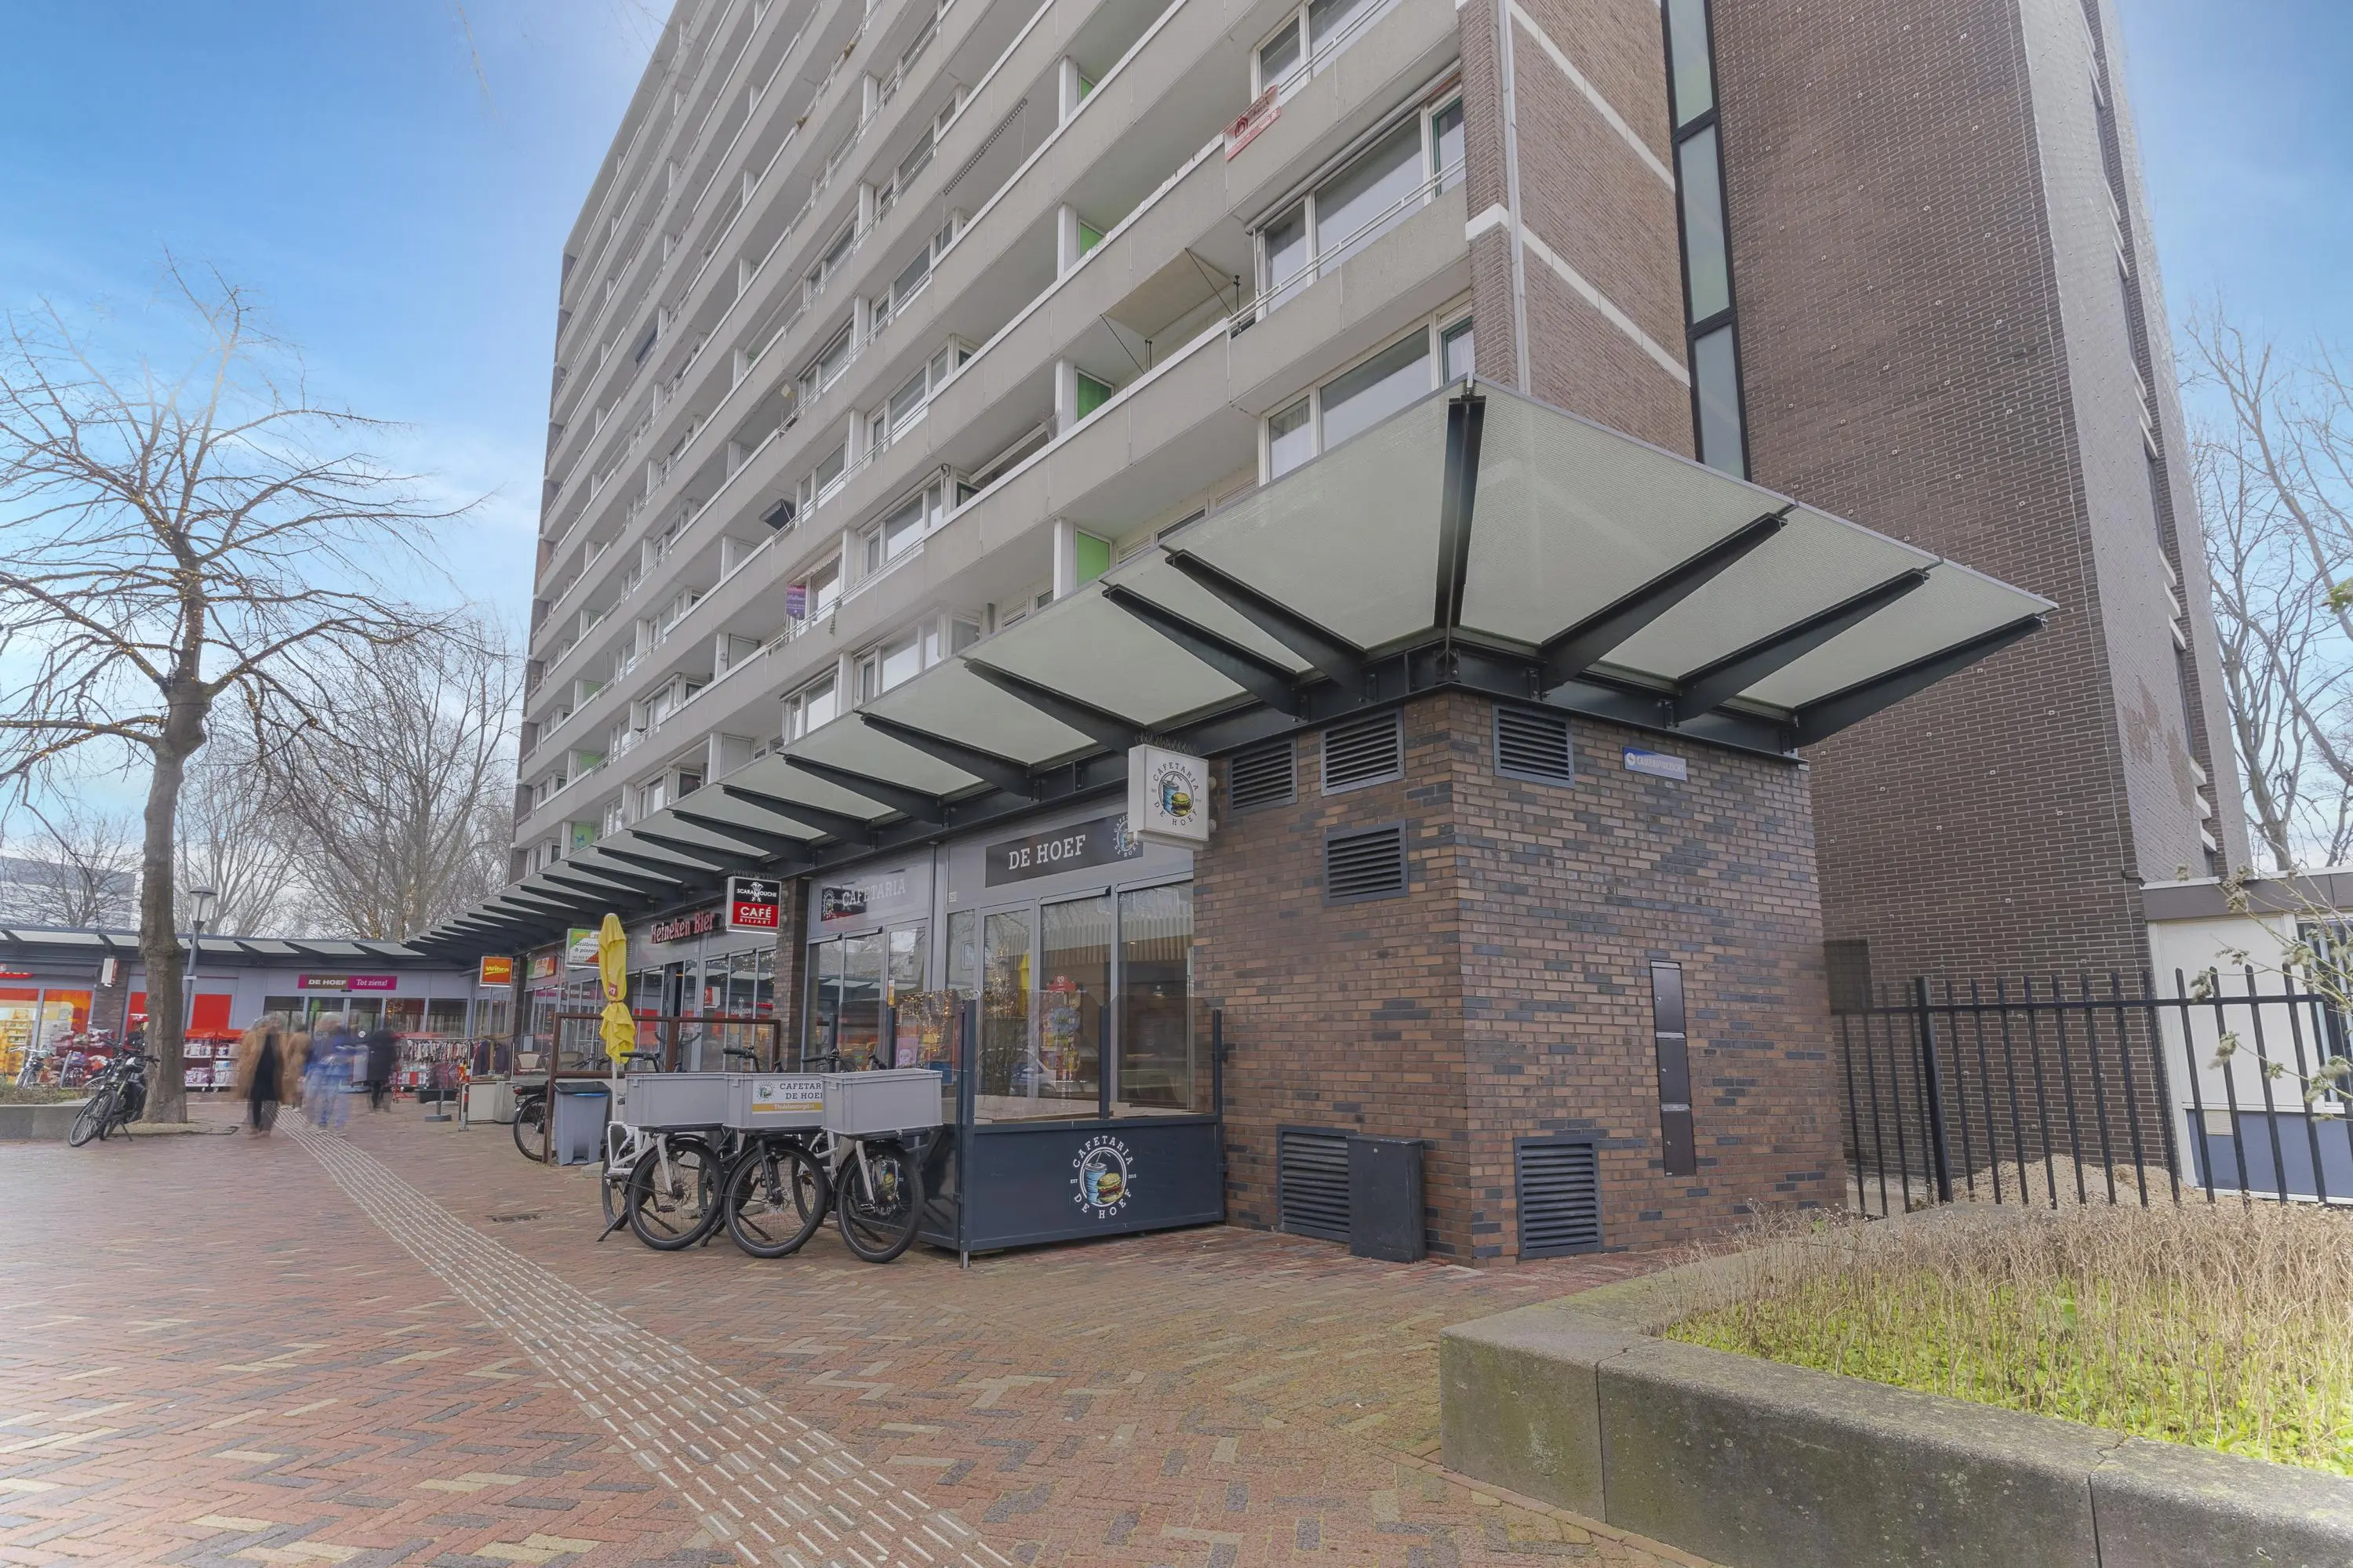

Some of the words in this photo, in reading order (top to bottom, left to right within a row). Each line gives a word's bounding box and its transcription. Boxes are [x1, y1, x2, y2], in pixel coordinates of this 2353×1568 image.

[1153, 762, 1199, 791] CAFETARIA
[1154, 802, 1166, 817] DE
[1172, 809, 1197, 826] HOEF
[1009, 848, 1030, 870] DE
[1036, 835, 1086, 864] HOEF
[842, 879, 906, 907] CAFETARIA
[740, 906, 771, 918] CAFÉ
[650, 917, 690, 944] Heineken
[1073, 1135, 1133, 1168] CAFETARIA
[1074, 1193, 1090, 1213] DE
[1098, 1188, 1132, 1219] HOEF
